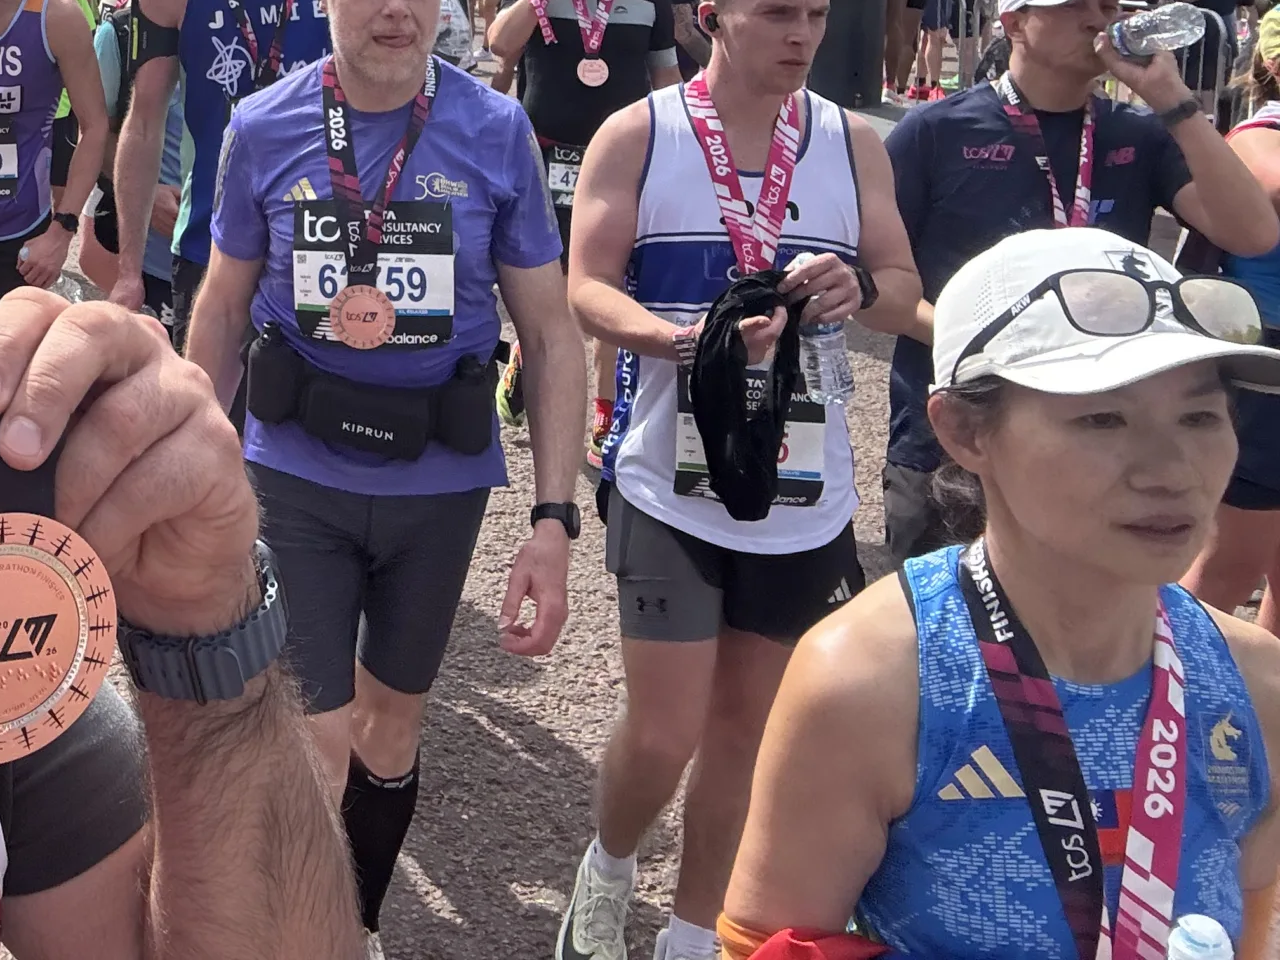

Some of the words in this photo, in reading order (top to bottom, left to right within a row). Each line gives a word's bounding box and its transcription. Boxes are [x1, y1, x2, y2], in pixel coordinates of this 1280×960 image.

[423, 53, 437, 98] FINISHE
[327, 106, 348, 152] 2026
[554, 145, 581, 162] tcs
[705, 134, 732, 177] 2026
[303, 209, 342, 243] tc
[381, 222, 442, 234] NSULTANCY
[318, 263, 428, 303] 659
[345, 310, 363, 322] tcs
[342, 421, 394, 441] KIPRUN
[35, 570, 66, 601] FINISHER
[45, 646, 58, 656] 26
[1143, 718, 1180, 819] 2026
[1061, 834, 1093, 882] tcs
